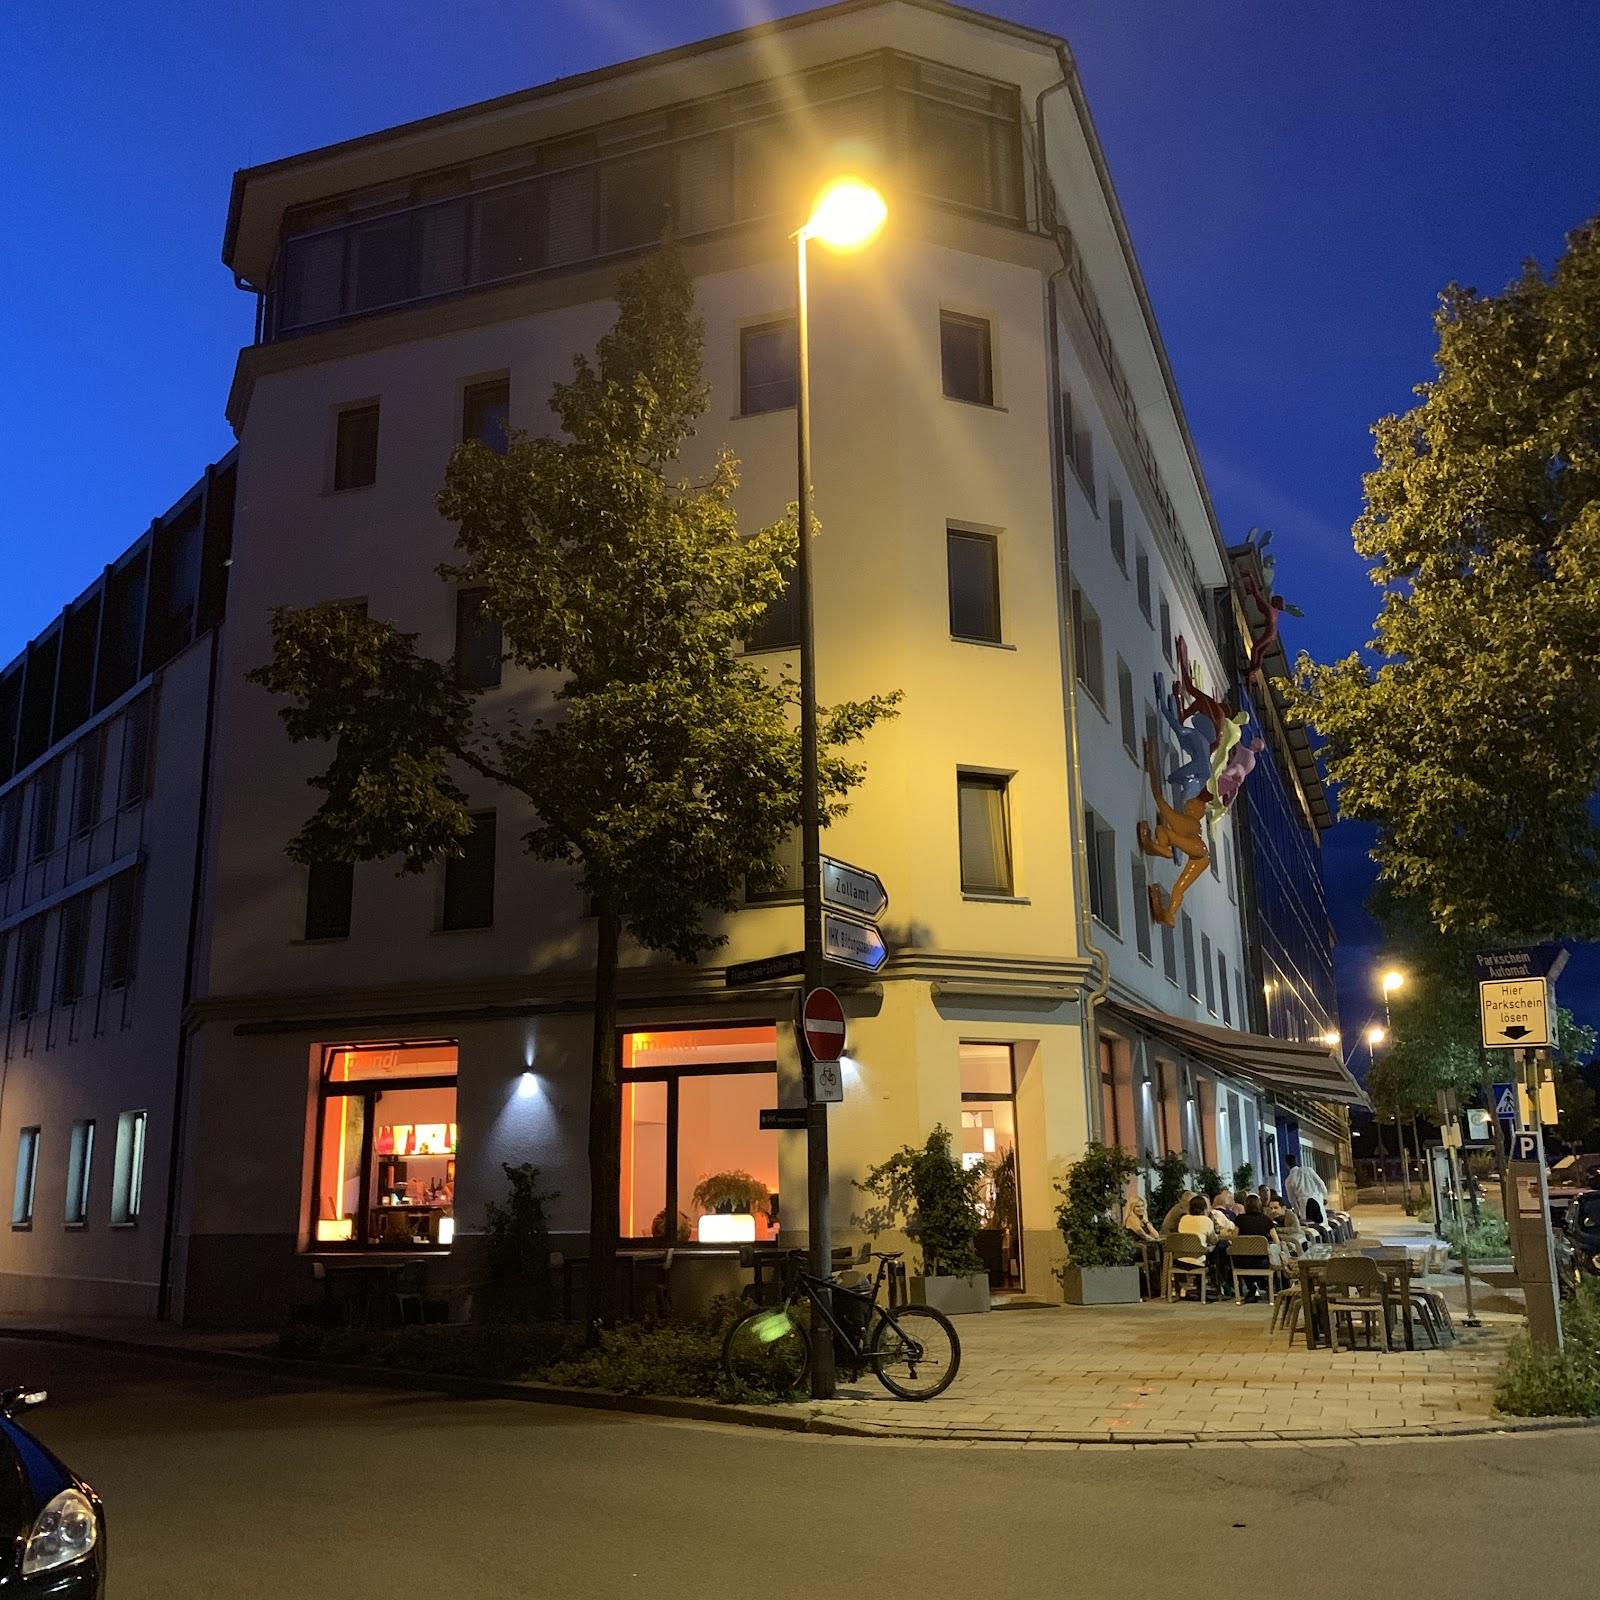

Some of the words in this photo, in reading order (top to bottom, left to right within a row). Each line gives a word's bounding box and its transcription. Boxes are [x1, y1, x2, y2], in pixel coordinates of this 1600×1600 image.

[835, 877, 869, 903] Zollamt
[1476, 952, 1531, 966] Parkschein
[1489, 964, 1531, 978] Automat
[1501, 986, 1523, 996] Hier
[1485, 998, 1543, 1010] Parkschein
[1500, 1013, 1528, 1023] lösen
[1519, 1136, 1535, 1159] P
